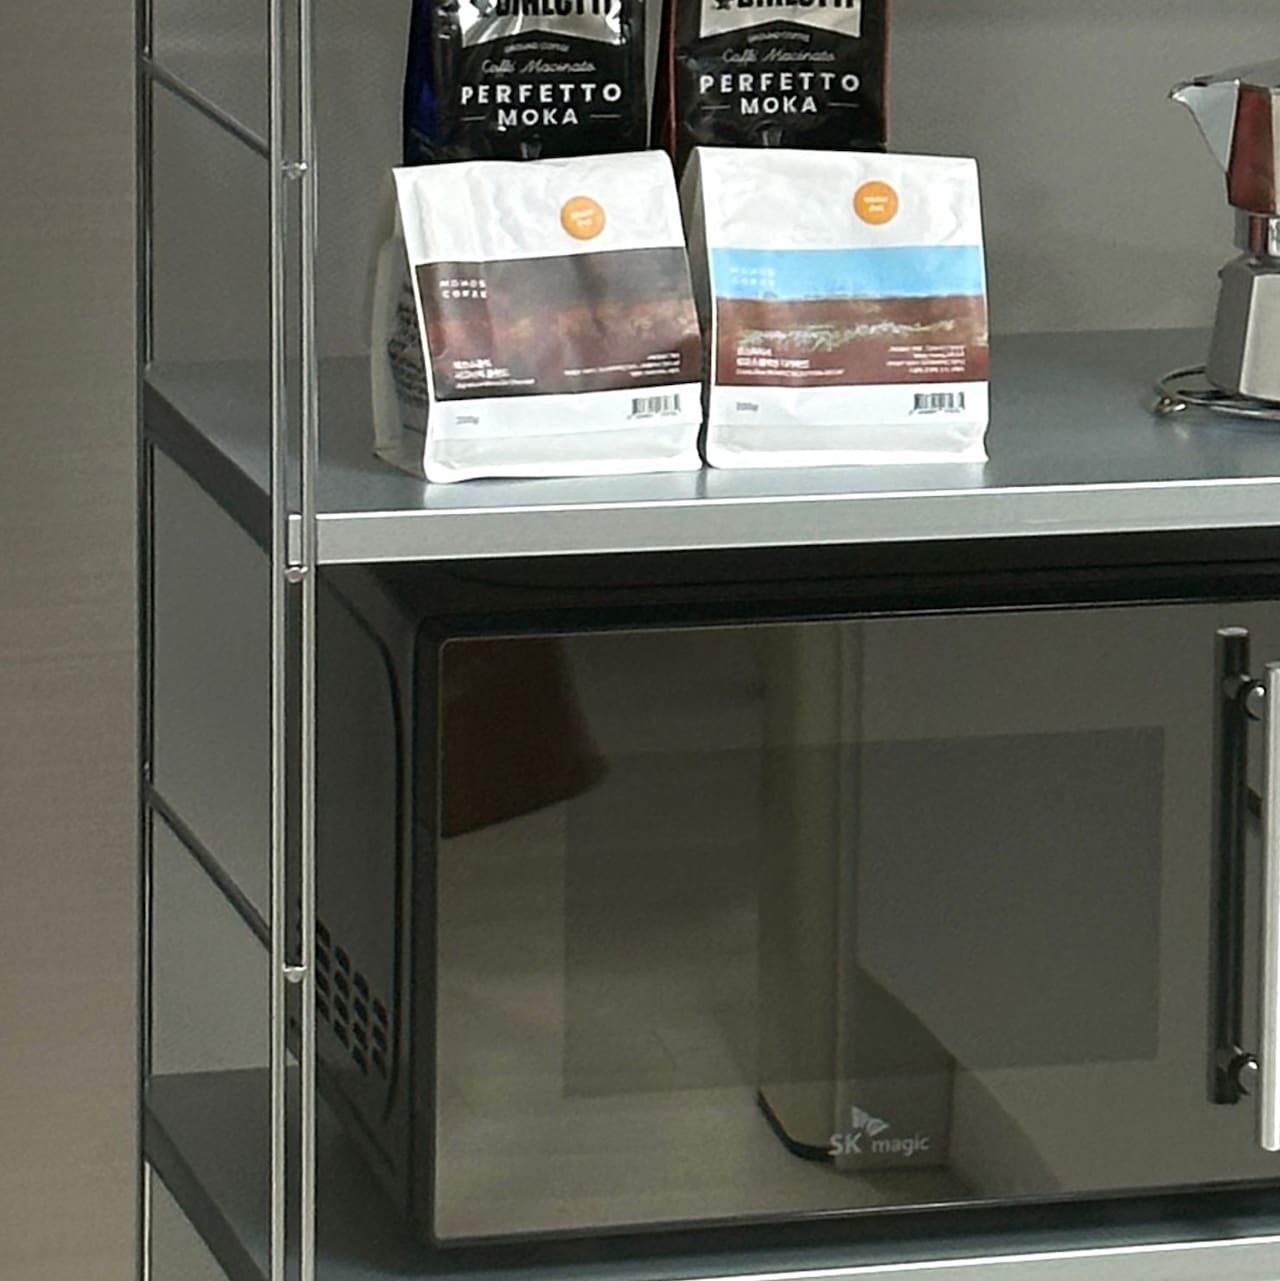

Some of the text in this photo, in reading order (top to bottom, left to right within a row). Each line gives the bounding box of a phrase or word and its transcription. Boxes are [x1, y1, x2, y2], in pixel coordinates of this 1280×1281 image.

[459, 82, 623, 105] PERFETTO
[699, 71, 861, 95] PERFETTO
[740, 95, 818, 115] MOKA
[497, 107, 579, 127] MOKA
[827, 1132, 932, 1158] SK magic
